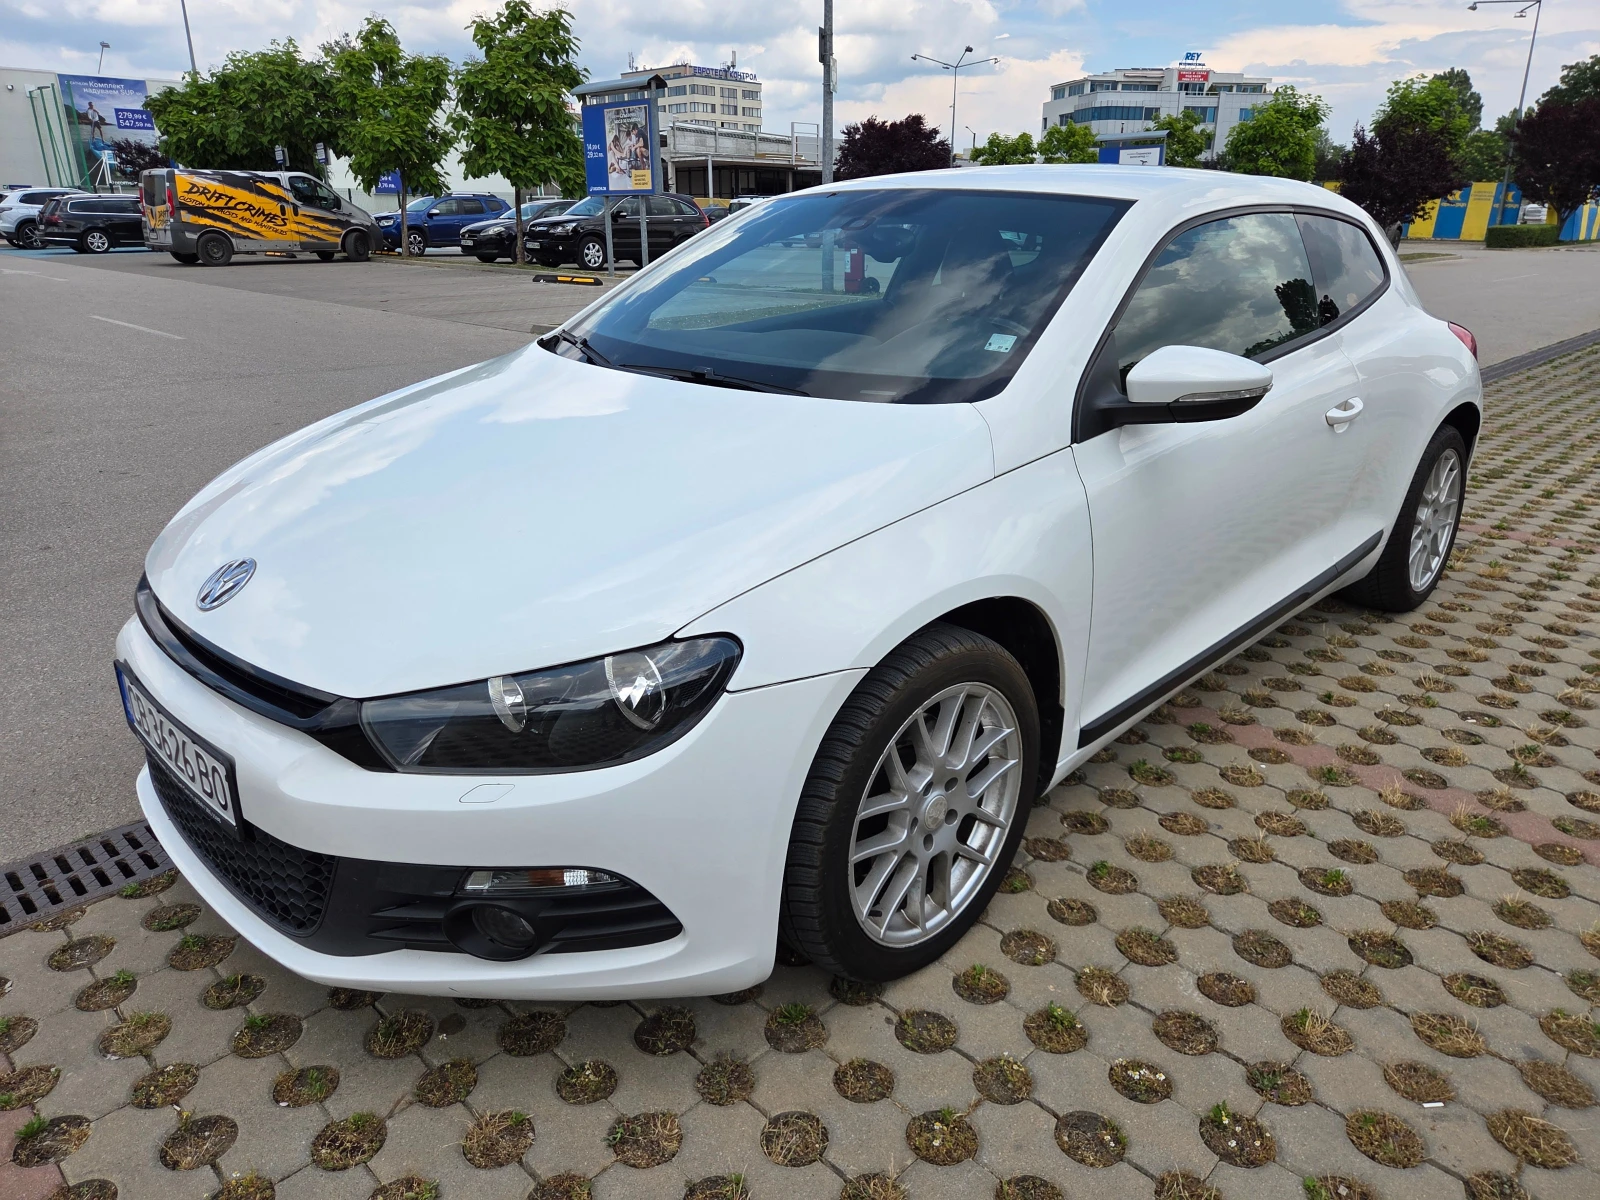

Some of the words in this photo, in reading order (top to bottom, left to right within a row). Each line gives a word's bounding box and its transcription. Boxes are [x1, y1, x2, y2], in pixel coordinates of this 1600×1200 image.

[1184, 52, 1202, 61] REY
[729, 70, 758, 81] КОНТРОЛ
[88, 80, 124, 90] Комплект
[83, 87, 119, 96] надуваем
[178, 195, 206, 207] CUSTOM
[238, 215, 253, 224] AND
[183, 182, 238, 207] DRIFT
[234, 201, 289, 227] CRIMES
